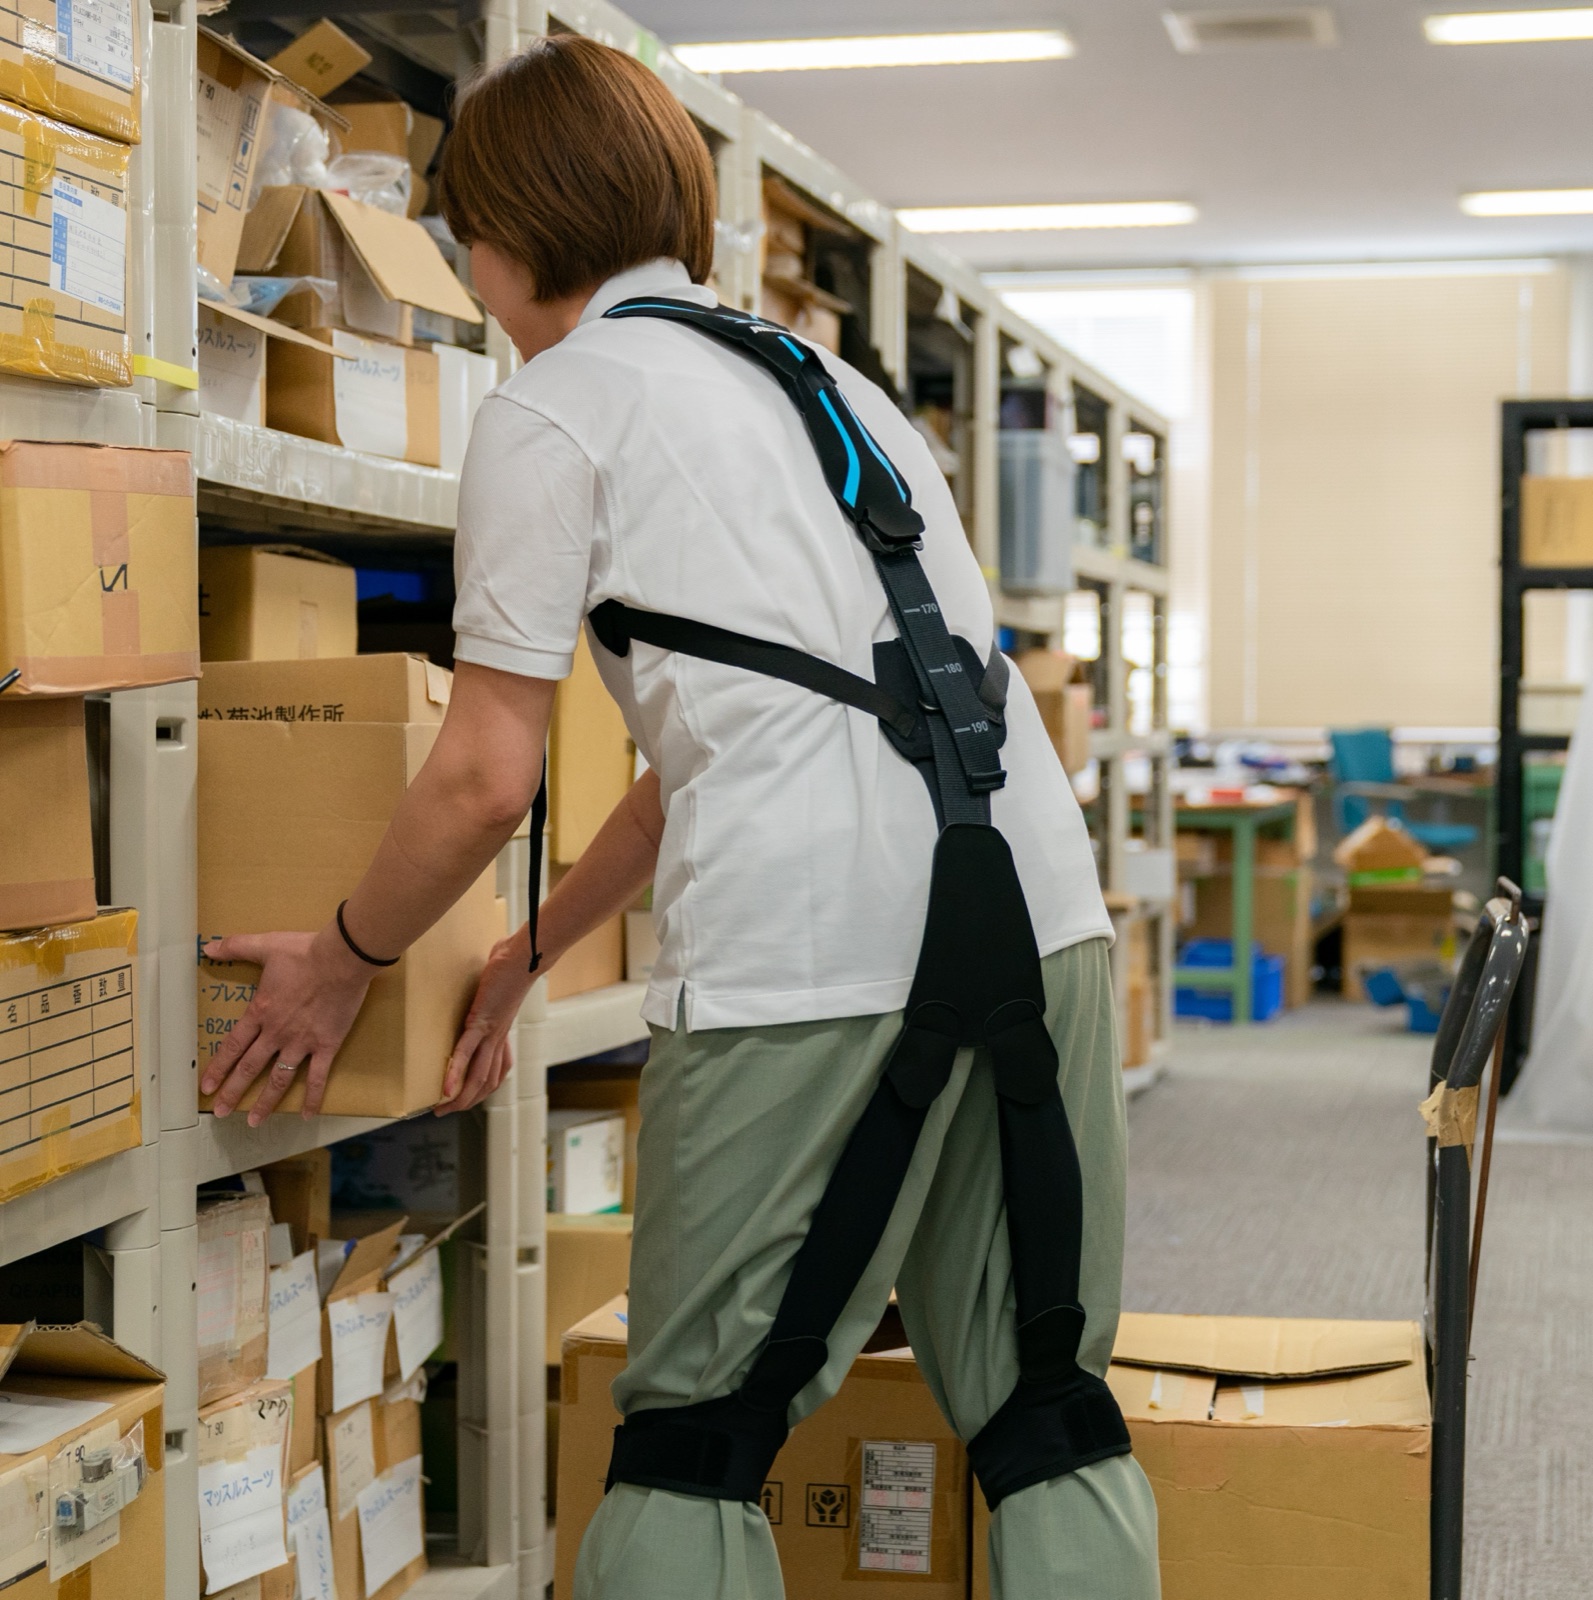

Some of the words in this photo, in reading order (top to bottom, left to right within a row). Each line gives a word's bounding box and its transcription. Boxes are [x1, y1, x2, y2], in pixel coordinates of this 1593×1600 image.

[206, 84, 215, 101] 90
[921, 603, 938, 613] 170
[944, 663, 963, 673] 180
[971, 721, 989, 733] 190
[206, 1424, 212, 1439] T
[214, 1421, 224, 1436] 90
[66, 1451, 72, 1469] T
[203, 1469, 275, 1508] マッスルスーツ
